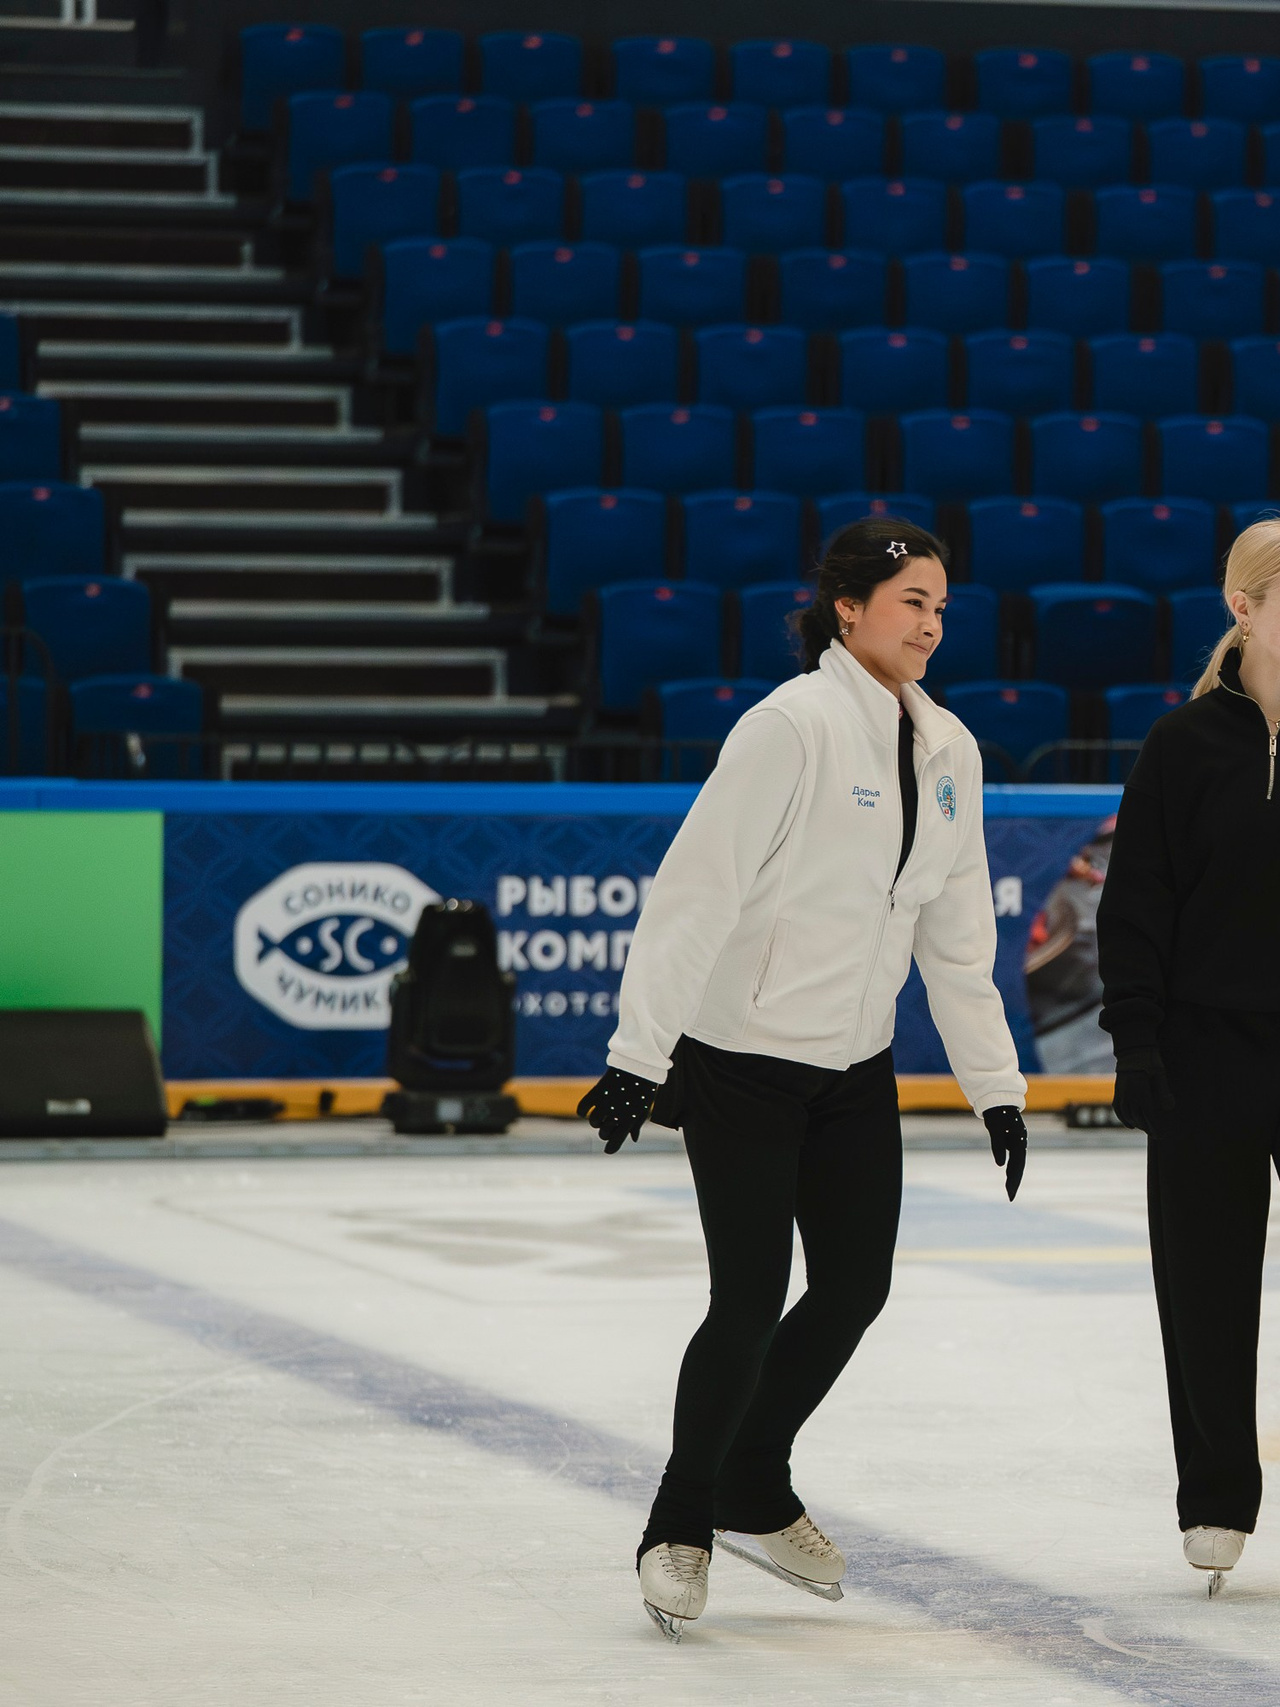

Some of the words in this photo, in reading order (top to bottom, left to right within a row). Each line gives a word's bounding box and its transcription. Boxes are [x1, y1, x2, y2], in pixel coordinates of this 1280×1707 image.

[852, 786, 881, 798] Дарья
[857, 797, 876, 808] Ким
[282, 881, 411, 915] СОНИКО
[511, 990, 620, 1018] ХОТС
